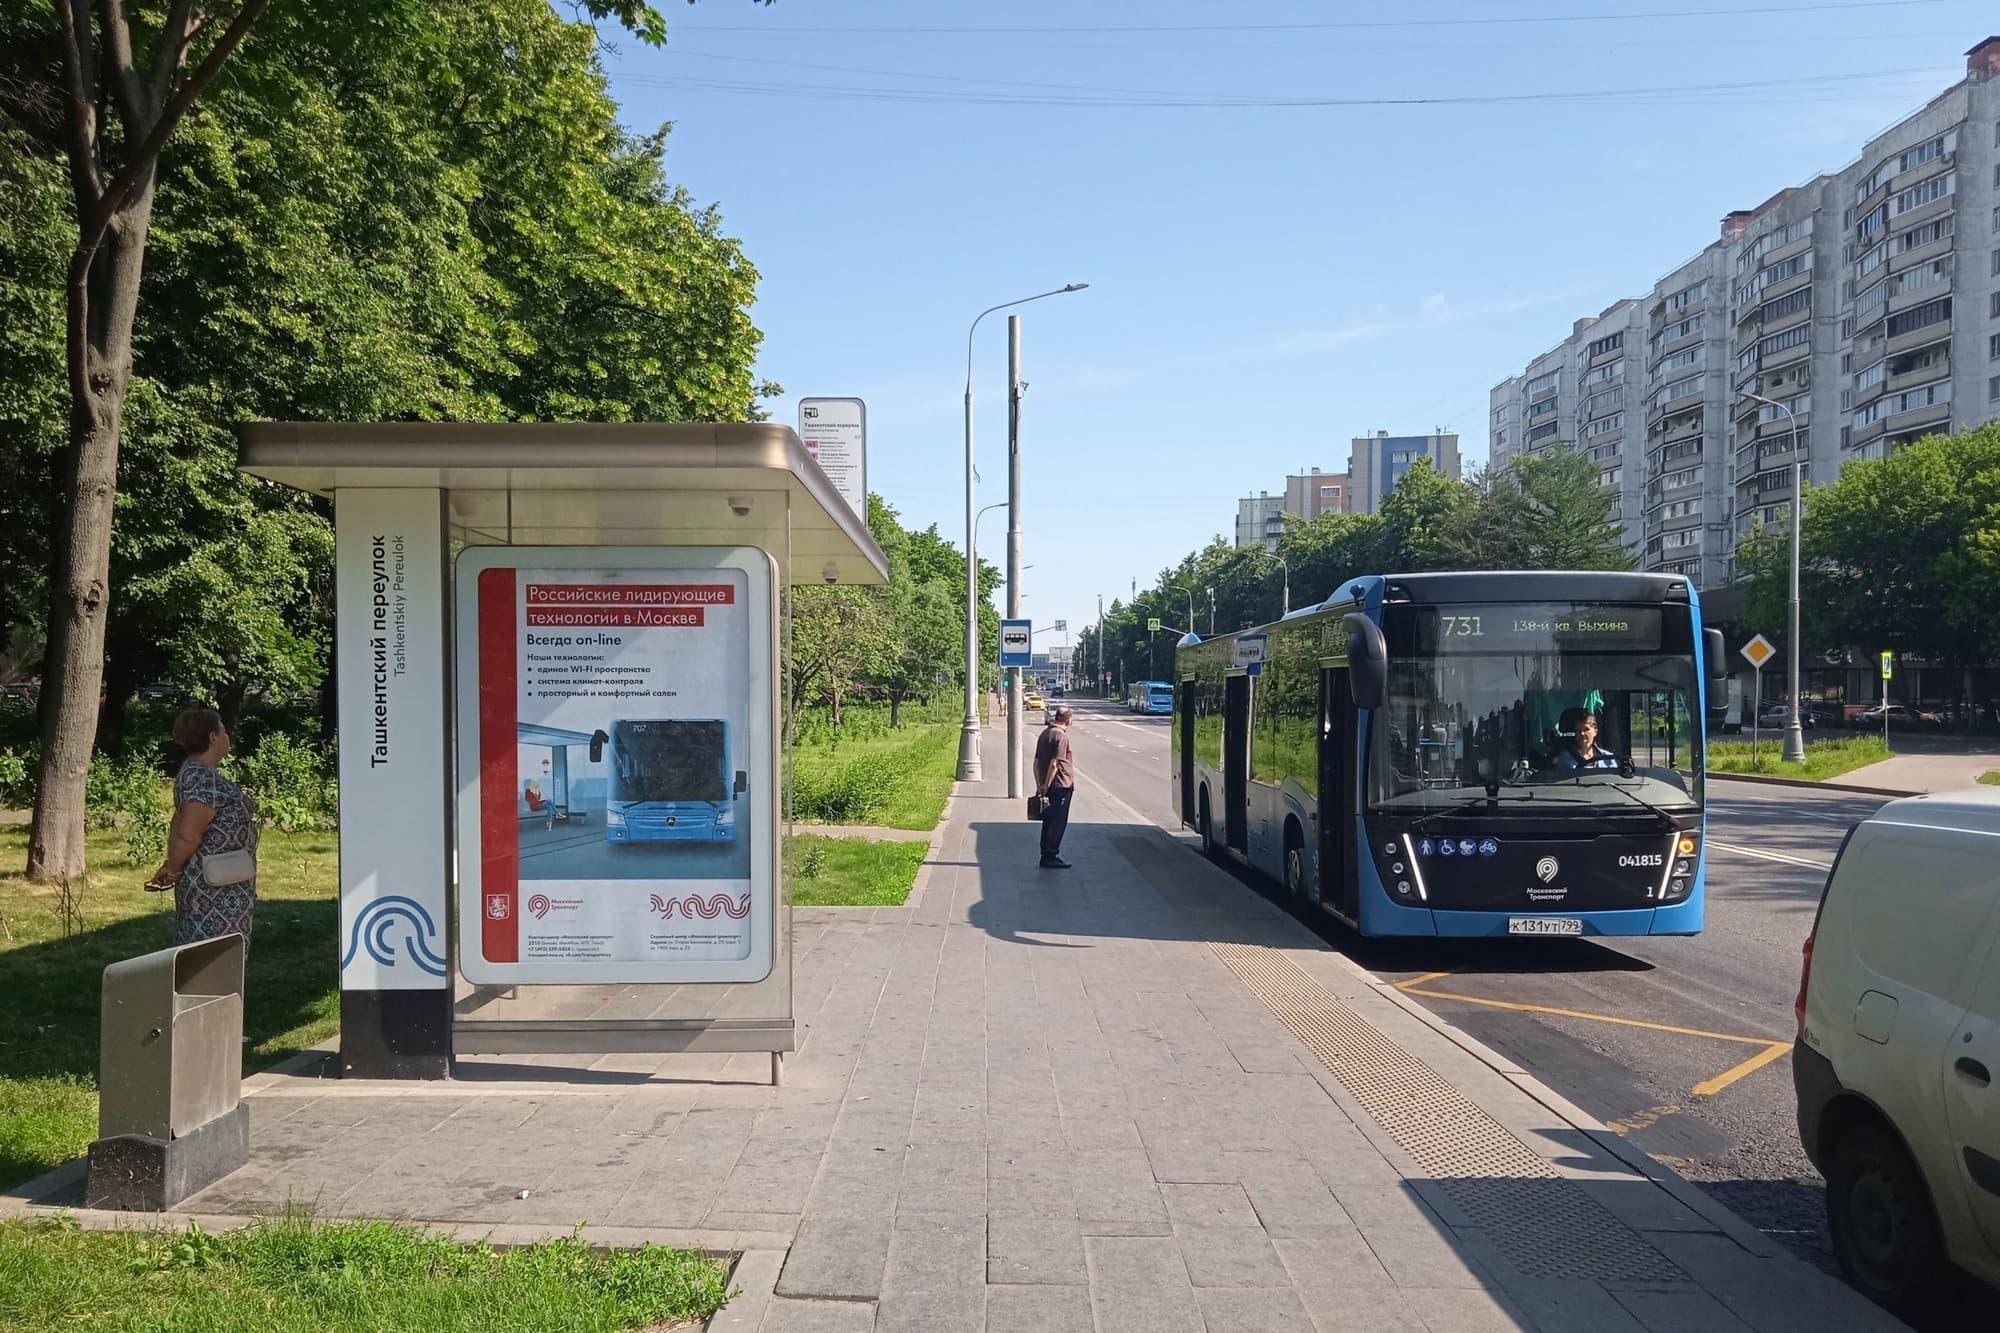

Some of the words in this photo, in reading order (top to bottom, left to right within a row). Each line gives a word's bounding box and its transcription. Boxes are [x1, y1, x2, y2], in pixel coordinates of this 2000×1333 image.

[392, 535, 404, 591] Pereulok
[372, 535, 389, 630] переулок
[529, 586, 620, 601] Российские
[625, 588, 726, 604] лидирующие
[529, 612, 619, 625] технологии
[624, 613, 632, 625] в
[637, 610, 697, 625] Москве
[1442, 616, 1484, 637] 731
[1555, 622, 1572, 632] кв.
[1578, 621, 1628, 632] Выхина
[393, 595, 407, 677] Tashkentskiy
[527, 633, 572, 647] Всегда
[576, 633, 622, 646] on-line
[537, 689, 589, 698] просторный
[598, 689, 651, 698] комфортный
[370, 638, 388, 768] Ташкентский
[1619, 855, 1662, 867] 041815
[1647, 886, 1653, 897] 1
